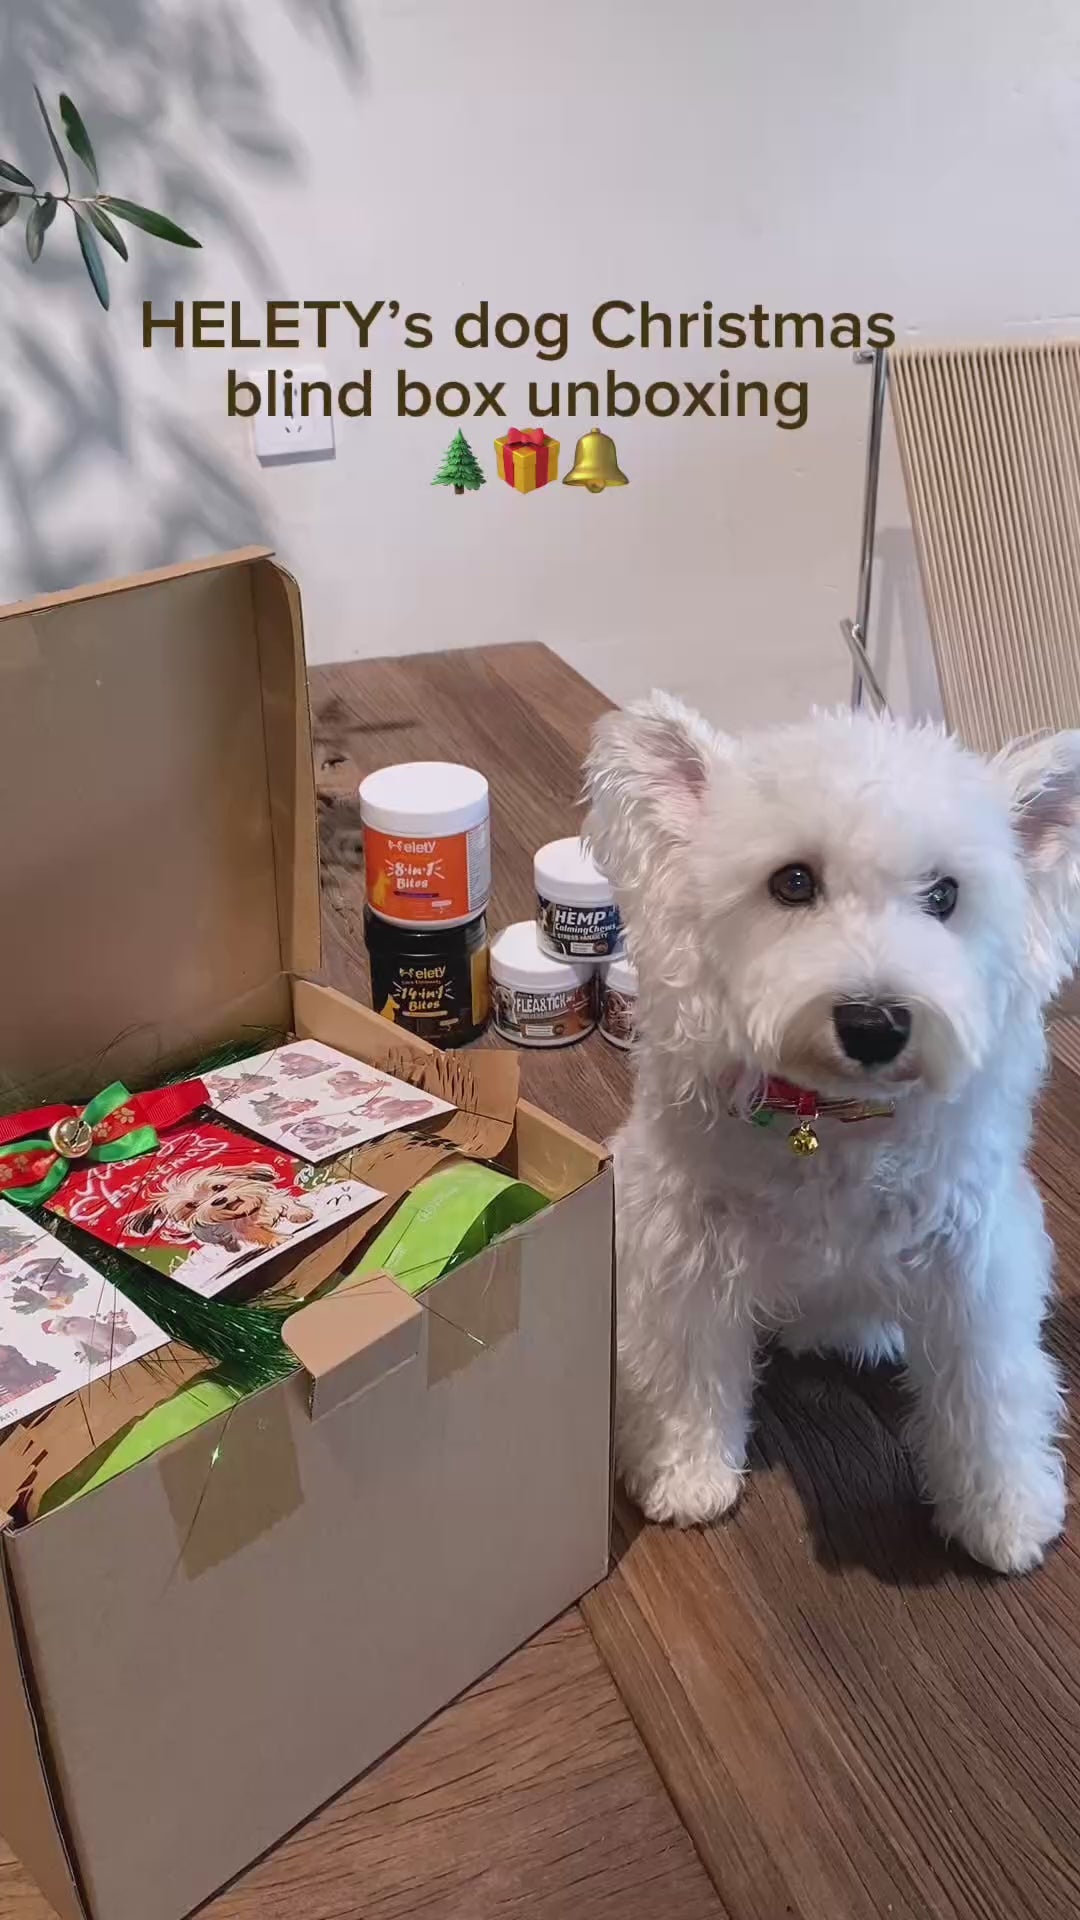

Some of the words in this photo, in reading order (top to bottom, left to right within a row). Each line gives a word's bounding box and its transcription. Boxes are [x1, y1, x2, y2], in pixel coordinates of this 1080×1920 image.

[396, 878, 428, 889] Bites
[555, 910, 607, 925] HEMP
[408, 1000, 440, 1012] Bites
